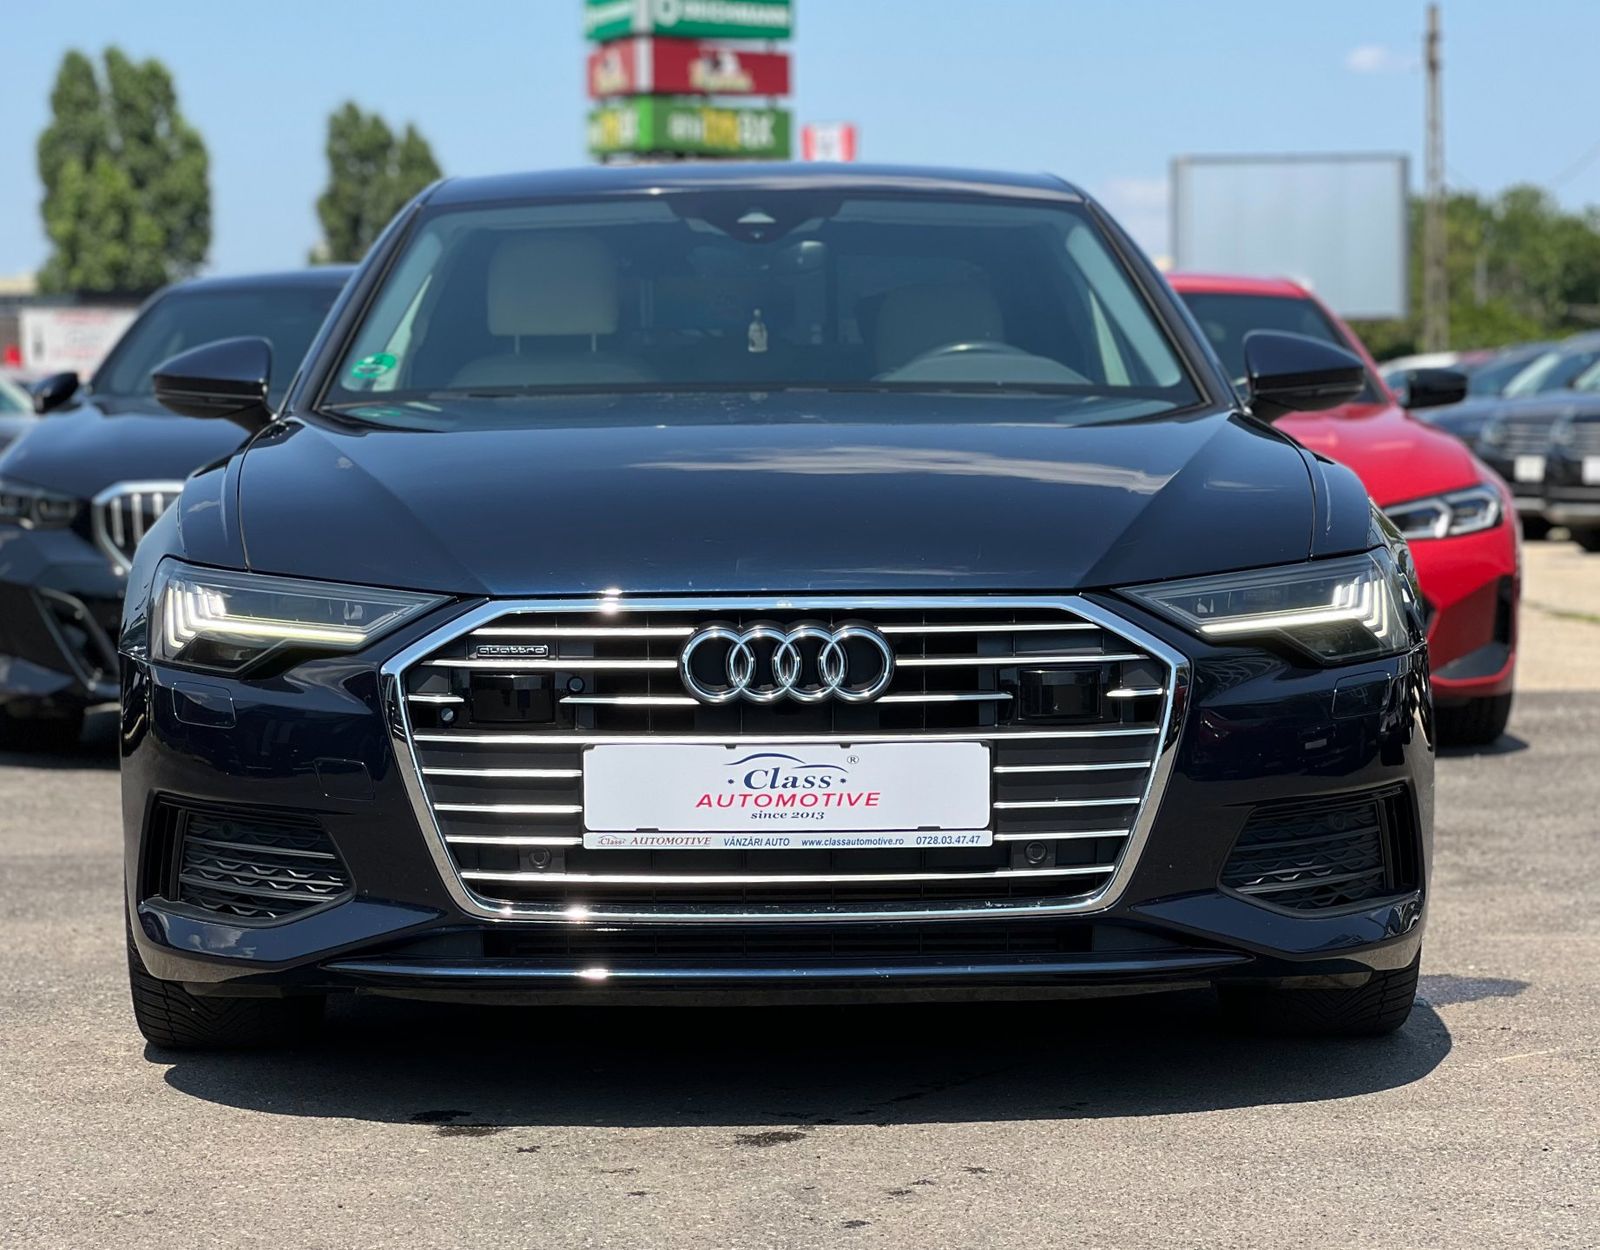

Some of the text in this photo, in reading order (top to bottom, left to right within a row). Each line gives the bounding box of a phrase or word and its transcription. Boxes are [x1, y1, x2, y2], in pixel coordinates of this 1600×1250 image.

[479, 646, 545, 654] quattro
[743, 767, 832, 790] Class
[695, 792, 881, 809] AUTOMOTIVE
[750, 810, 825, 820] since 2013
[630, 836, 712, 846] AUTOMOTIVE
[765, 837, 790, 847] AUTO
[801, 836, 905, 847] www.classautomotive.ro
[916, 835, 981, 845] 0728.03.47.47
